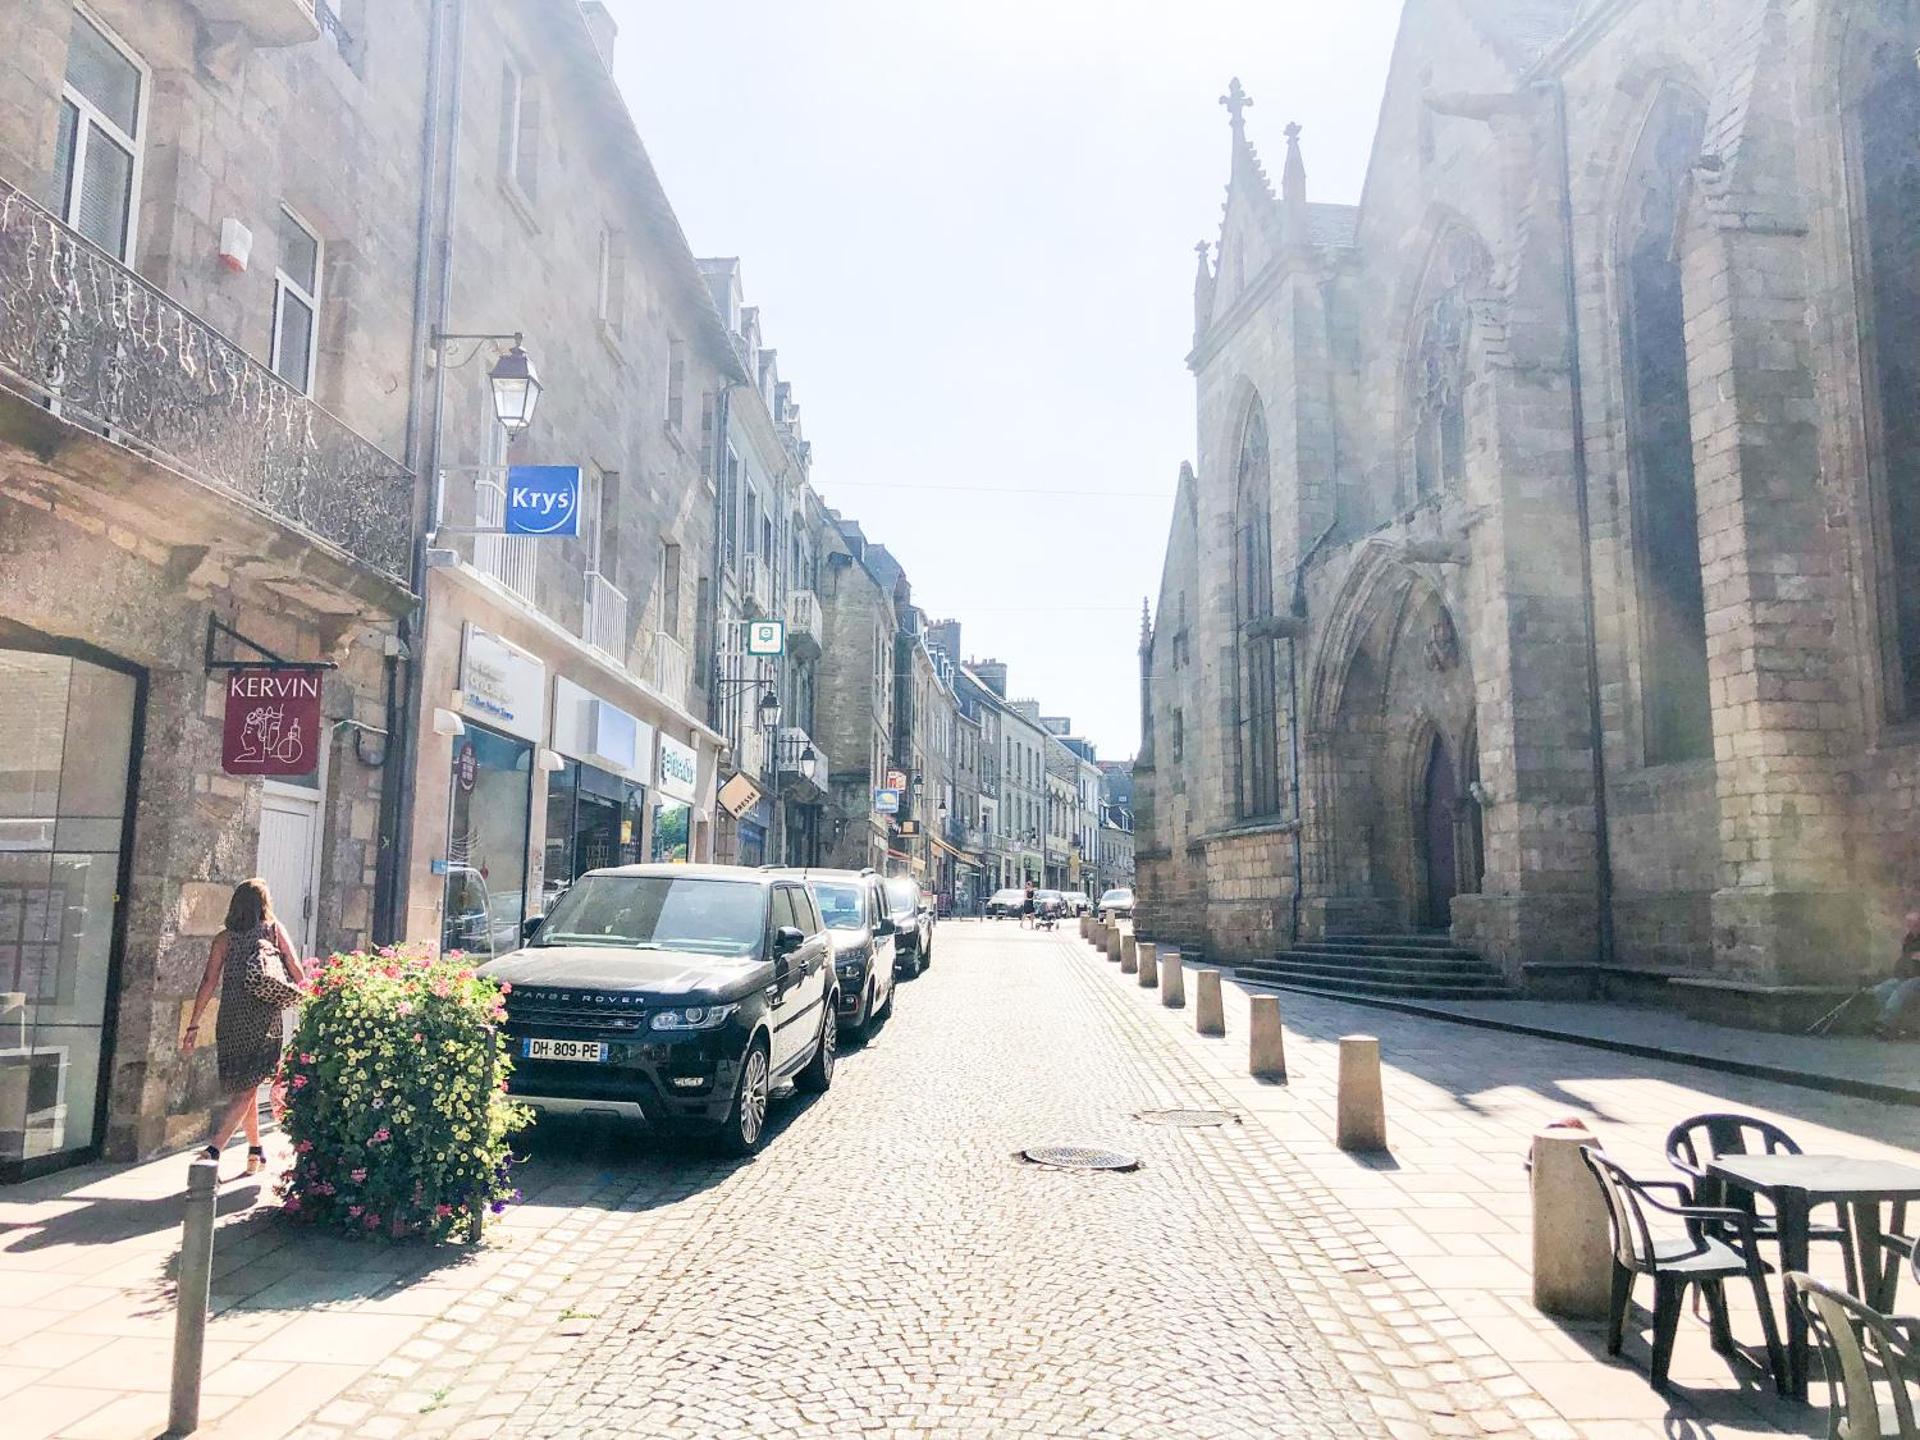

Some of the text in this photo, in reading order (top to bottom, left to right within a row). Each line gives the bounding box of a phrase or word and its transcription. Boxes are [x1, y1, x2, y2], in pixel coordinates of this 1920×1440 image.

[512, 487, 569, 515] Krys
[231, 677, 318, 697] KERVIN
[734, 792, 756, 813] PRESSE
[513, 990, 645, 1004] RANGE ROVER
[533, 1041, 598, 1058] DH-809-PE
